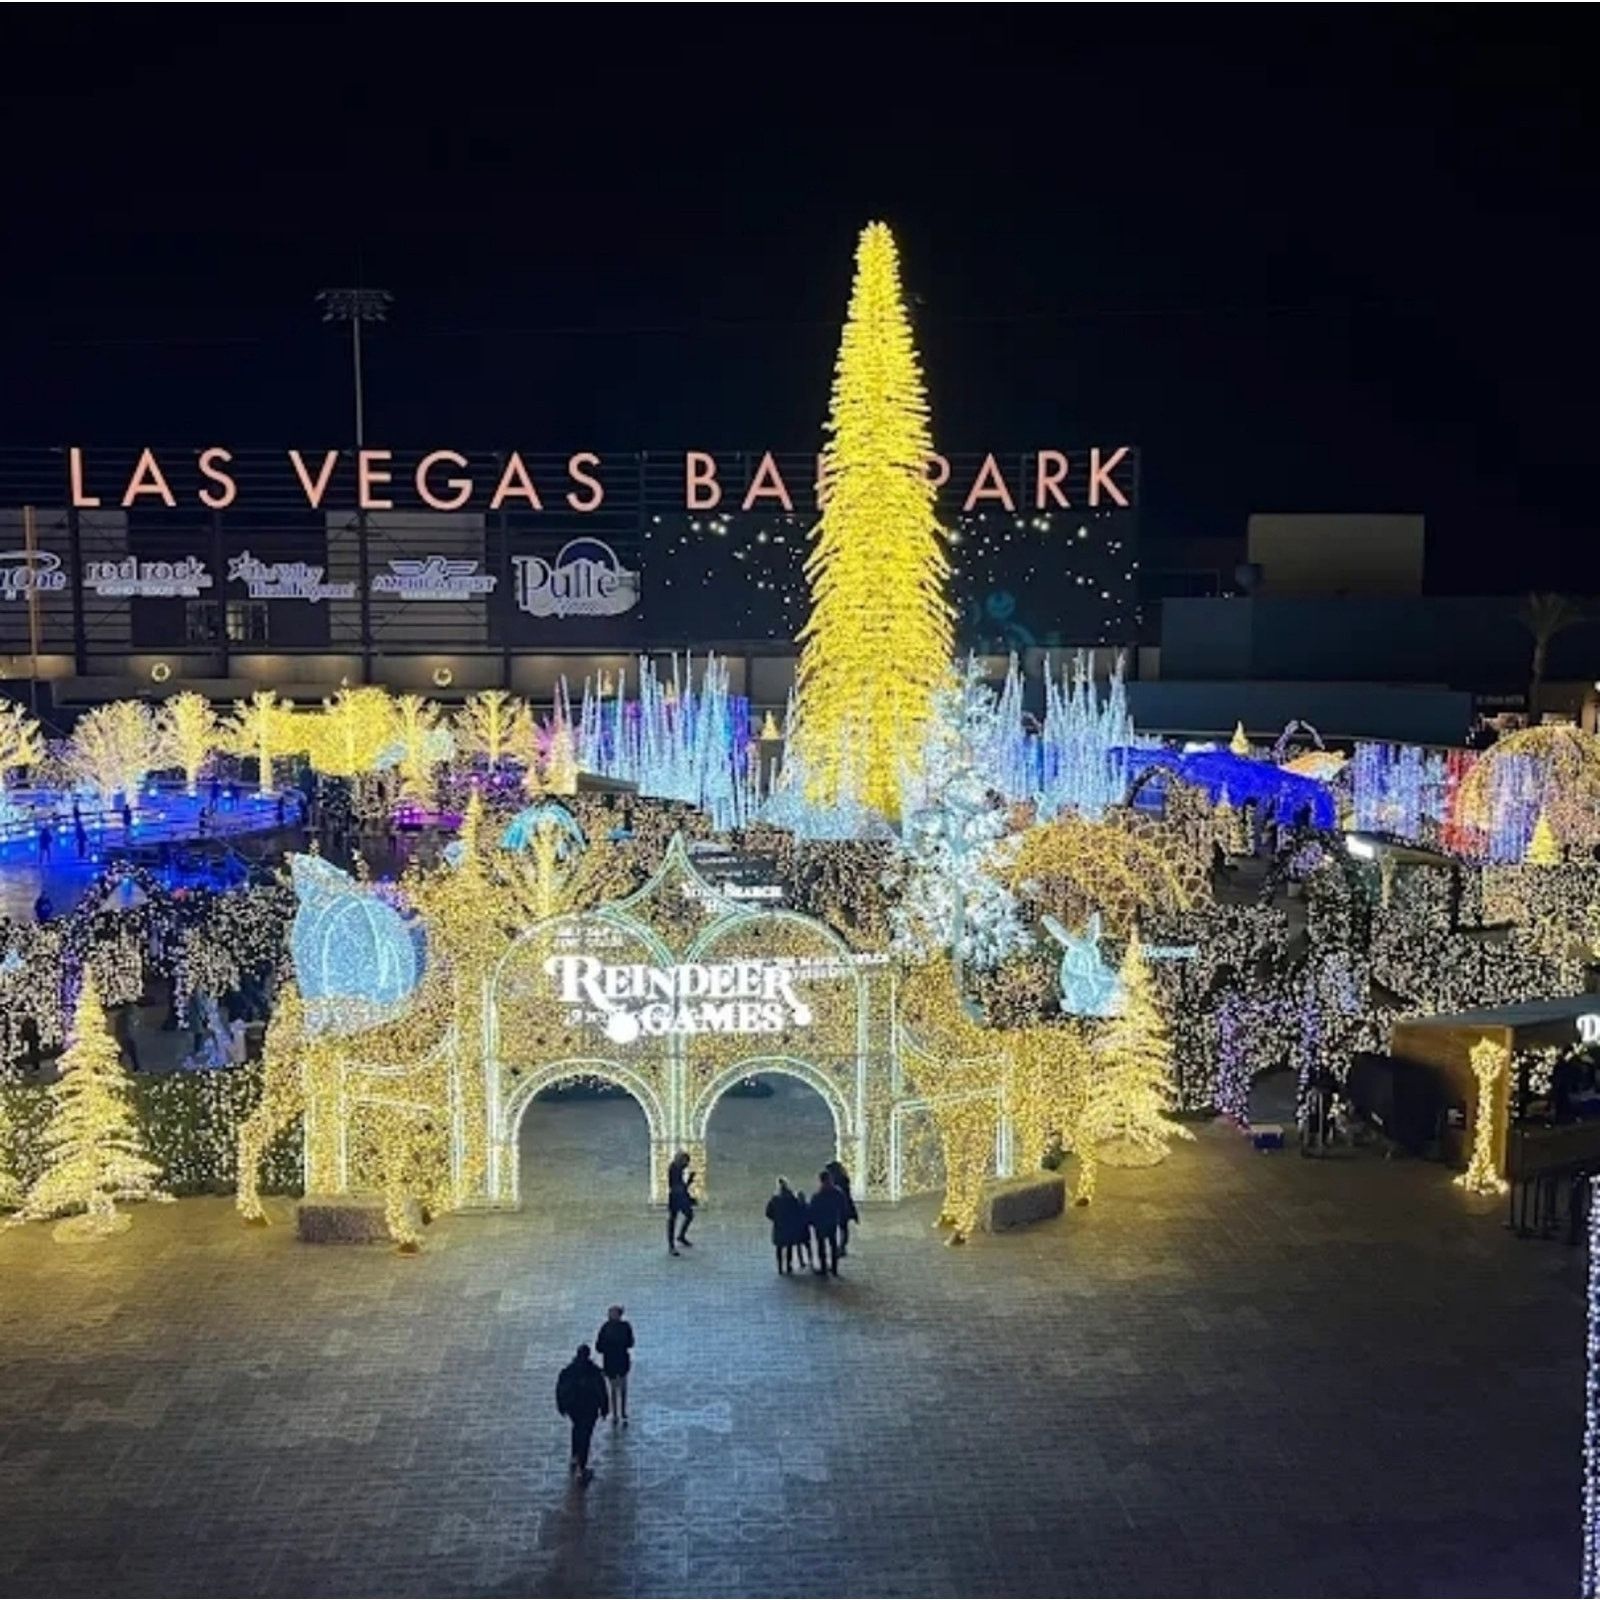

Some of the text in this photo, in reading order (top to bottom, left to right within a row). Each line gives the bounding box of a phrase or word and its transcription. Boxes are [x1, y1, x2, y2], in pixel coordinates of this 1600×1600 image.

[69, 446, 1131, 512] LAS VEGAS BAPARK
[86, 556, 137, 582] red
[511, 555, 620, 611] Pulte
[543, 955, 806, 1020] REINDEER
[640, 1001, 785, 1035] GAMES
